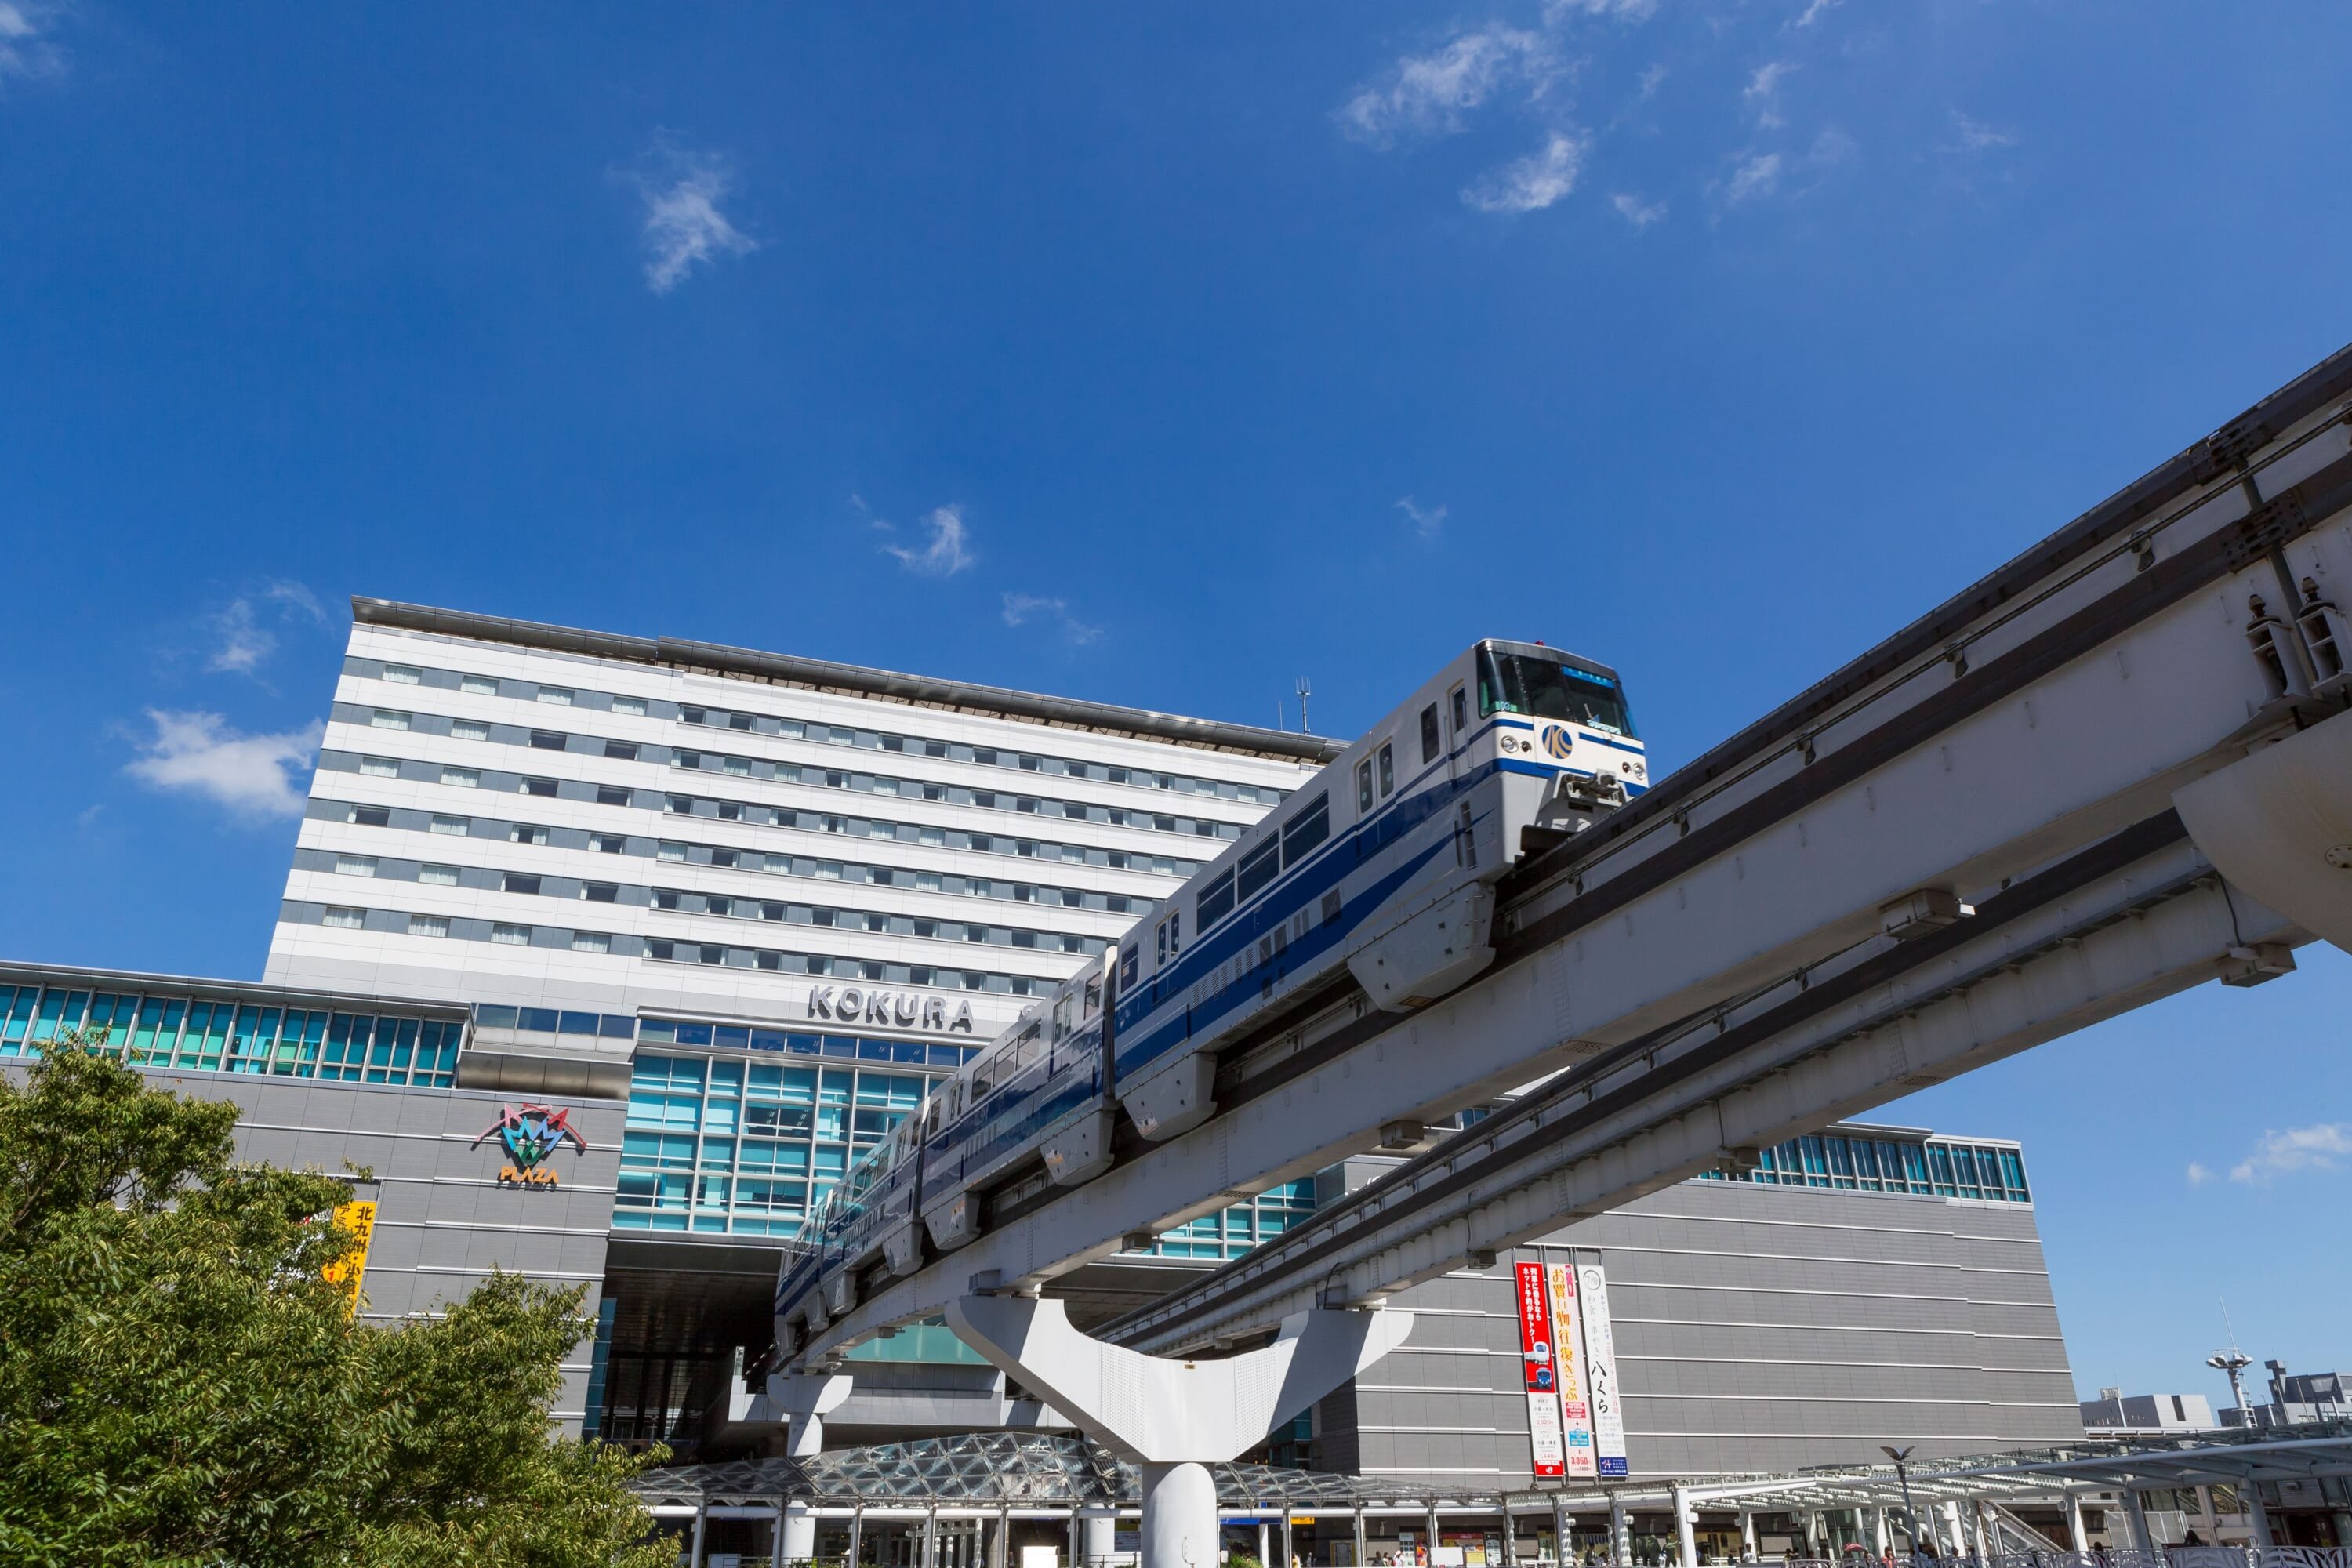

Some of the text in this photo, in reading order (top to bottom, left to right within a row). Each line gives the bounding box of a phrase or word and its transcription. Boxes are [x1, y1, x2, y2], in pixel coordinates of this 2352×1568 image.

[812, 985, 975, 1023] KOKURA
[500, 1166, 559, 1183] PLAZA
[1553, 1269, 1577, 1400] お買い物往復きっぷ
